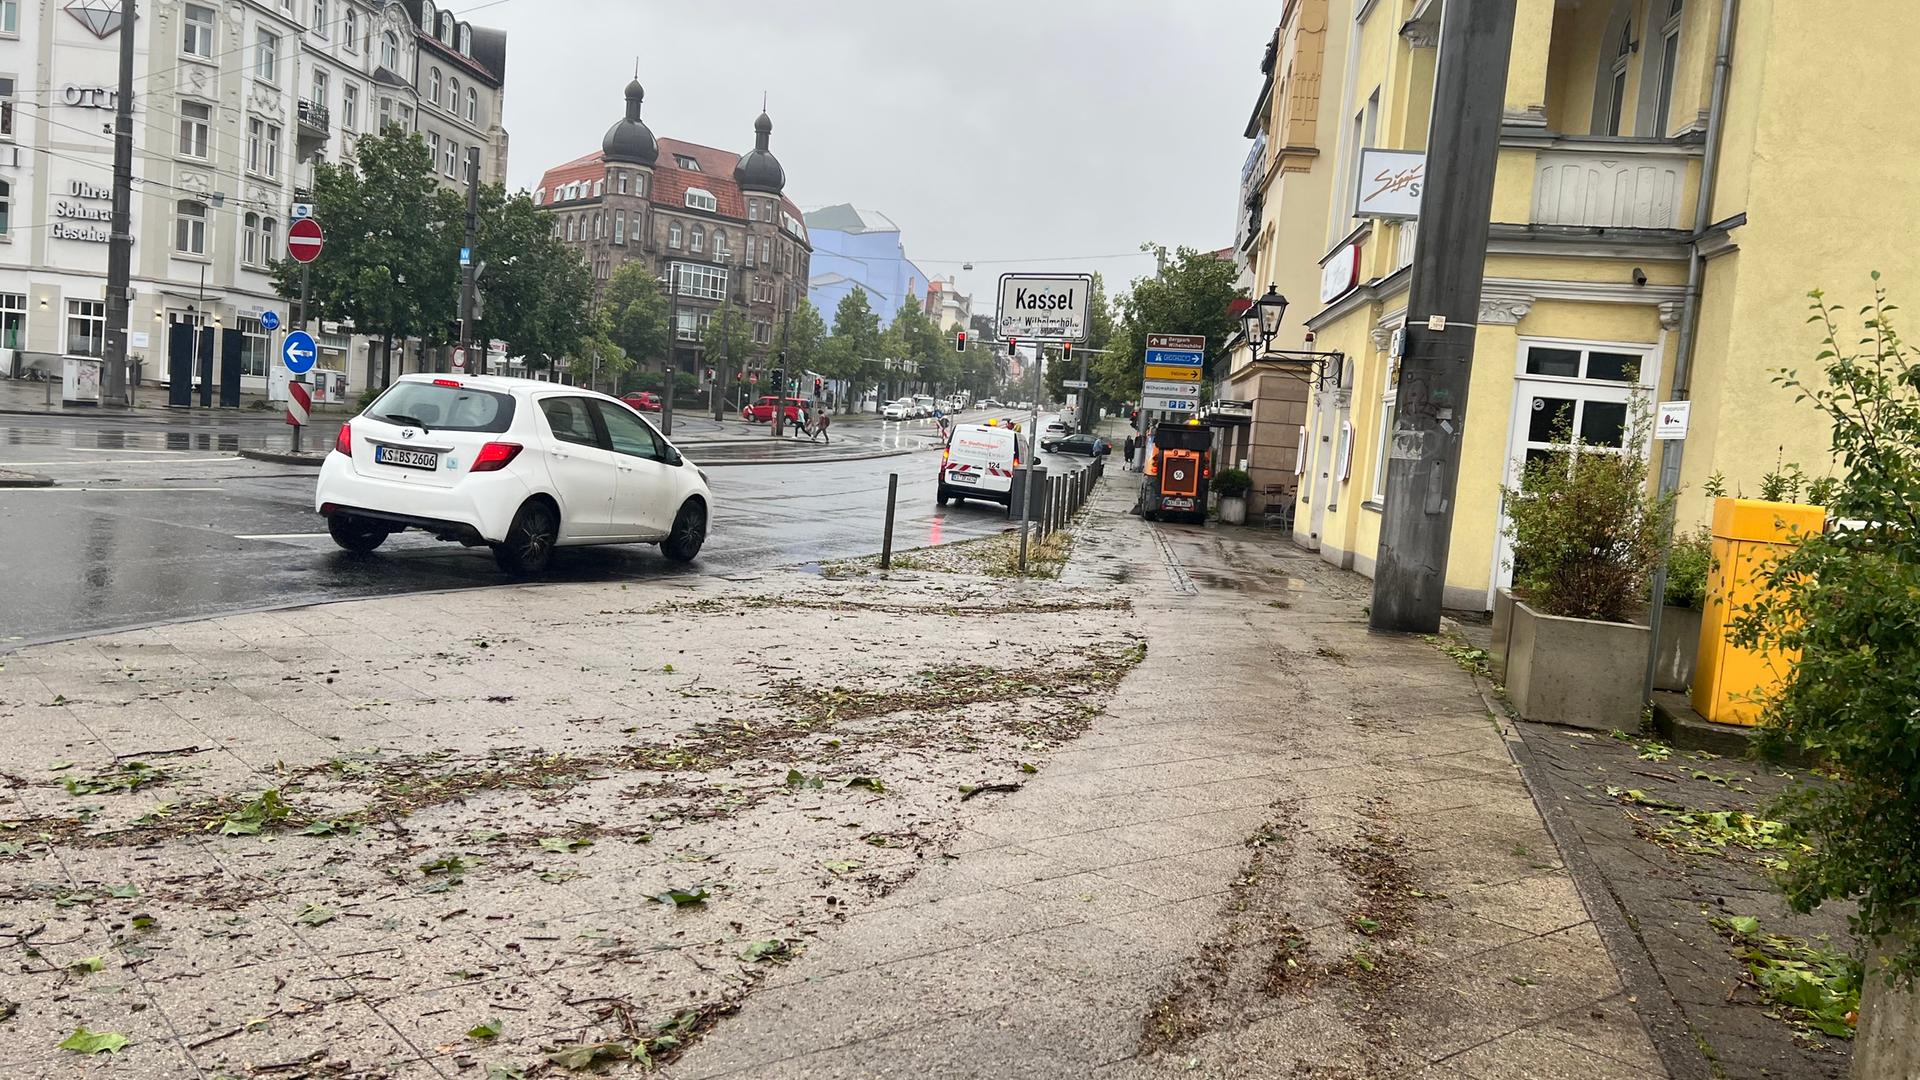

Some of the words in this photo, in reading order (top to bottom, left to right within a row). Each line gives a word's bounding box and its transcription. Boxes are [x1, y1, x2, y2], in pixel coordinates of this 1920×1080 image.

[62, 84, 135, 112] OTT
[1409, 182, 1422, 197] S
[1015, 287, 1073, 310] Kassel
[381, 447, 394, 461] KS
[399, 451, 411, 464] BS
[412, 453, 435, 467] 2606
